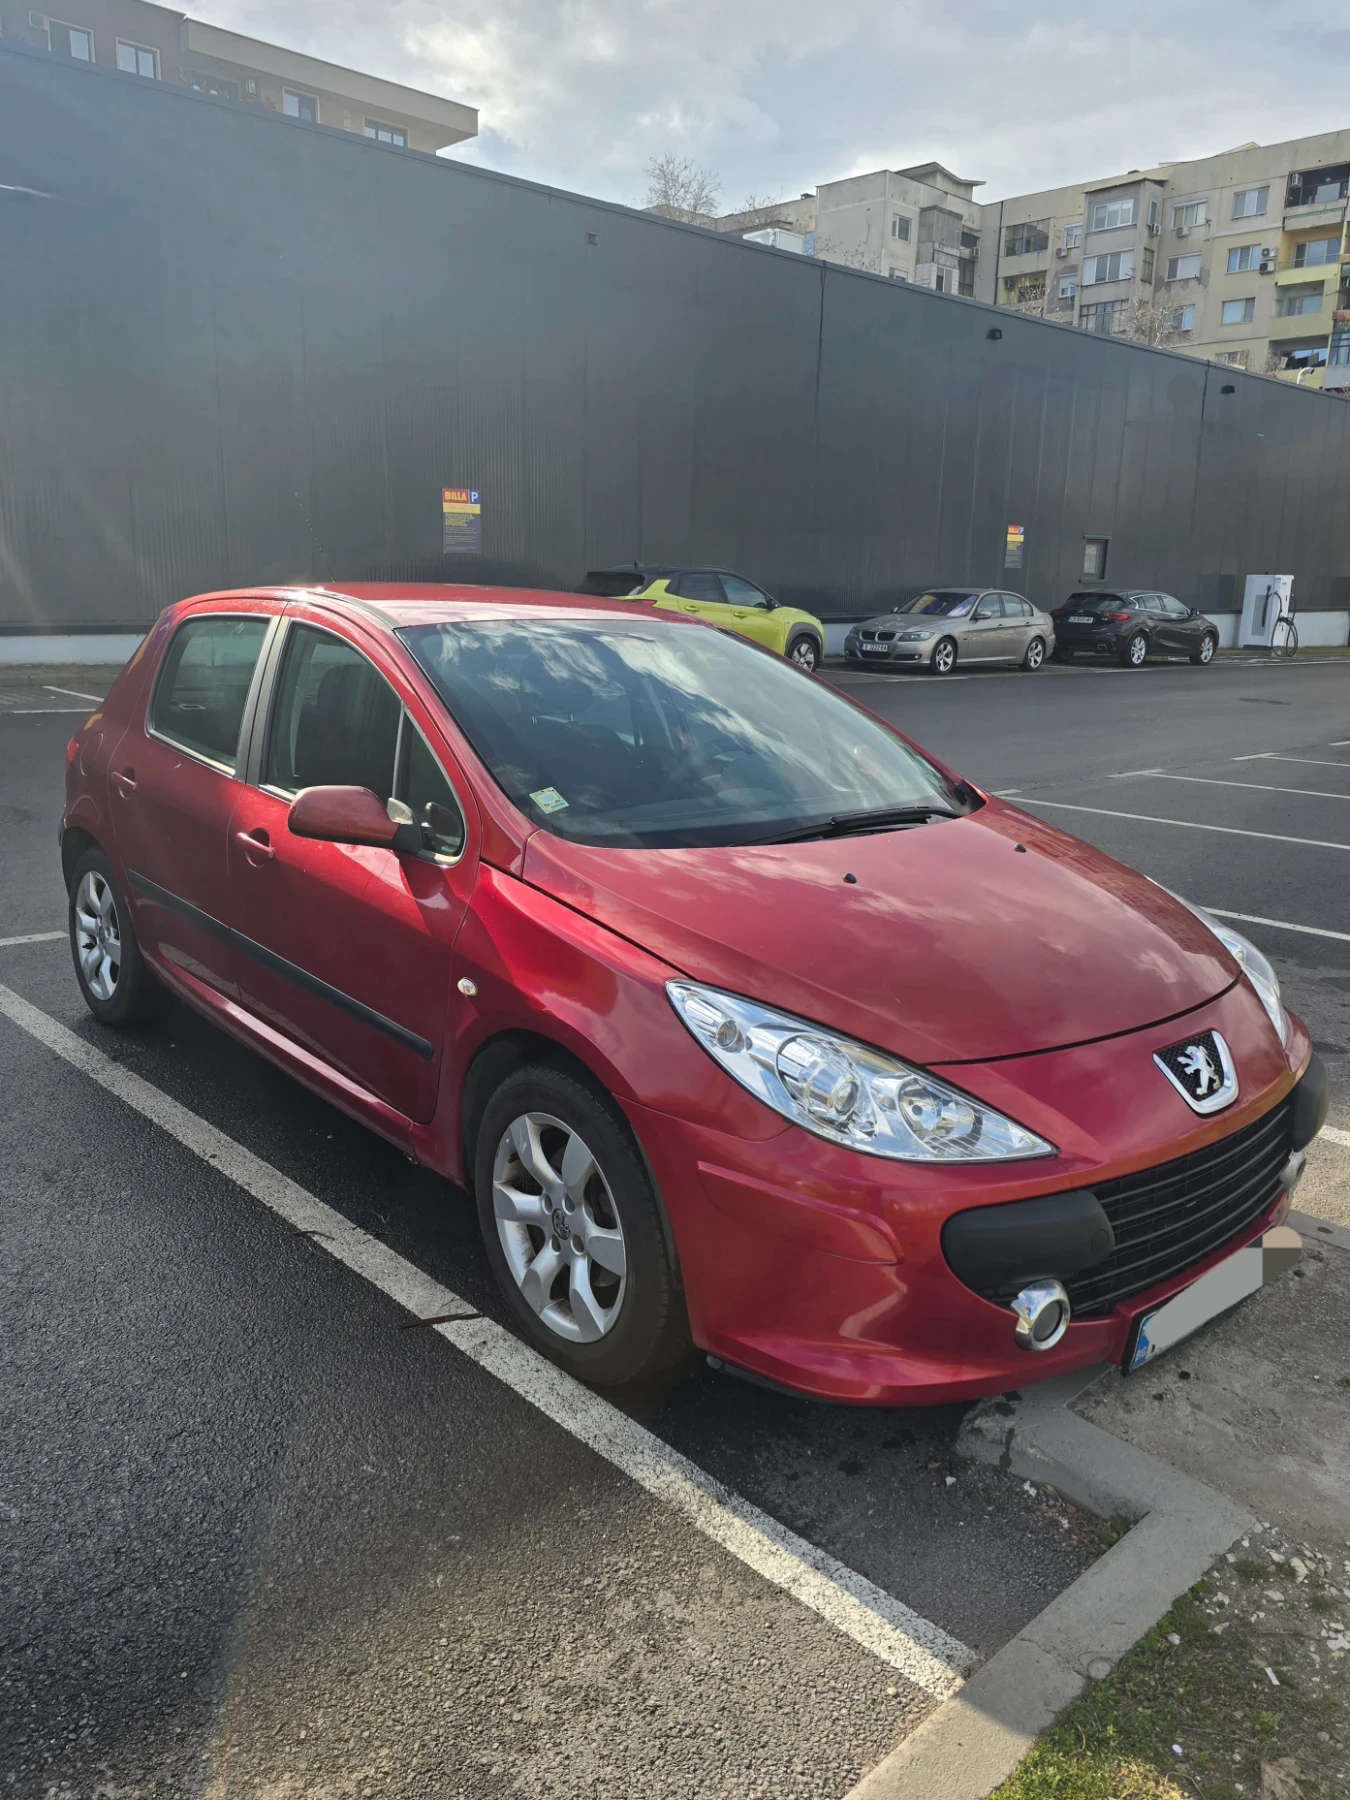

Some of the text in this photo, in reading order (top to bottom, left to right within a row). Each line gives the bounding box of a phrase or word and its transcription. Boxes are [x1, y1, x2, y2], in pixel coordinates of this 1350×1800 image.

[444, 491, 479, 503] BILLA P
[1135, 1346, 1147, 1361] BG
